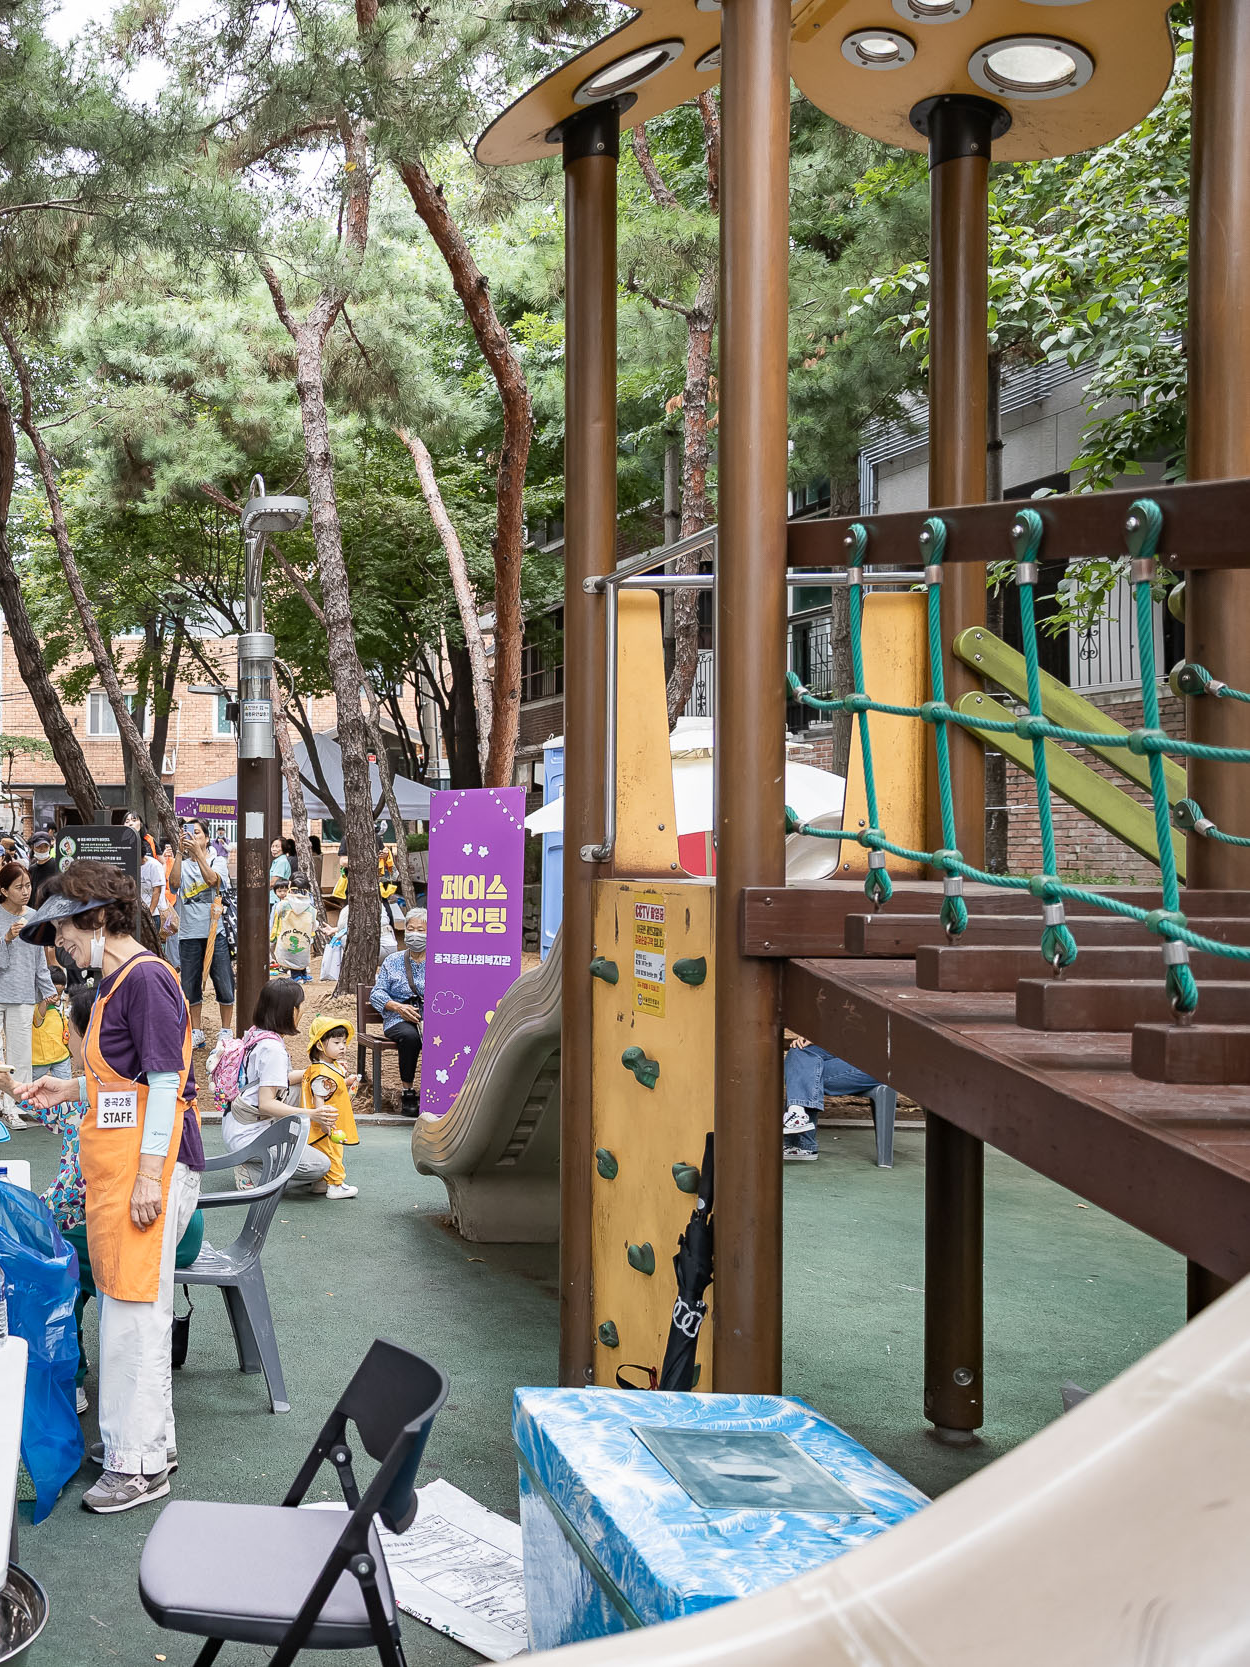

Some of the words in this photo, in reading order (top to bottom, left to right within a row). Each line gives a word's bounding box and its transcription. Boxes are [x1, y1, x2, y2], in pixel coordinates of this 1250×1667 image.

[440, 874, 508, 900] 페이스
[439, 907, 507, 934] 페인팅
[635, 904, 650, 919] CCTV
[651, 907, 664, 921] 촬영중
[434, 953, 511, 966] 중곡종합사회복지관
[104, 1097, 132, 1107] 중곡2동
